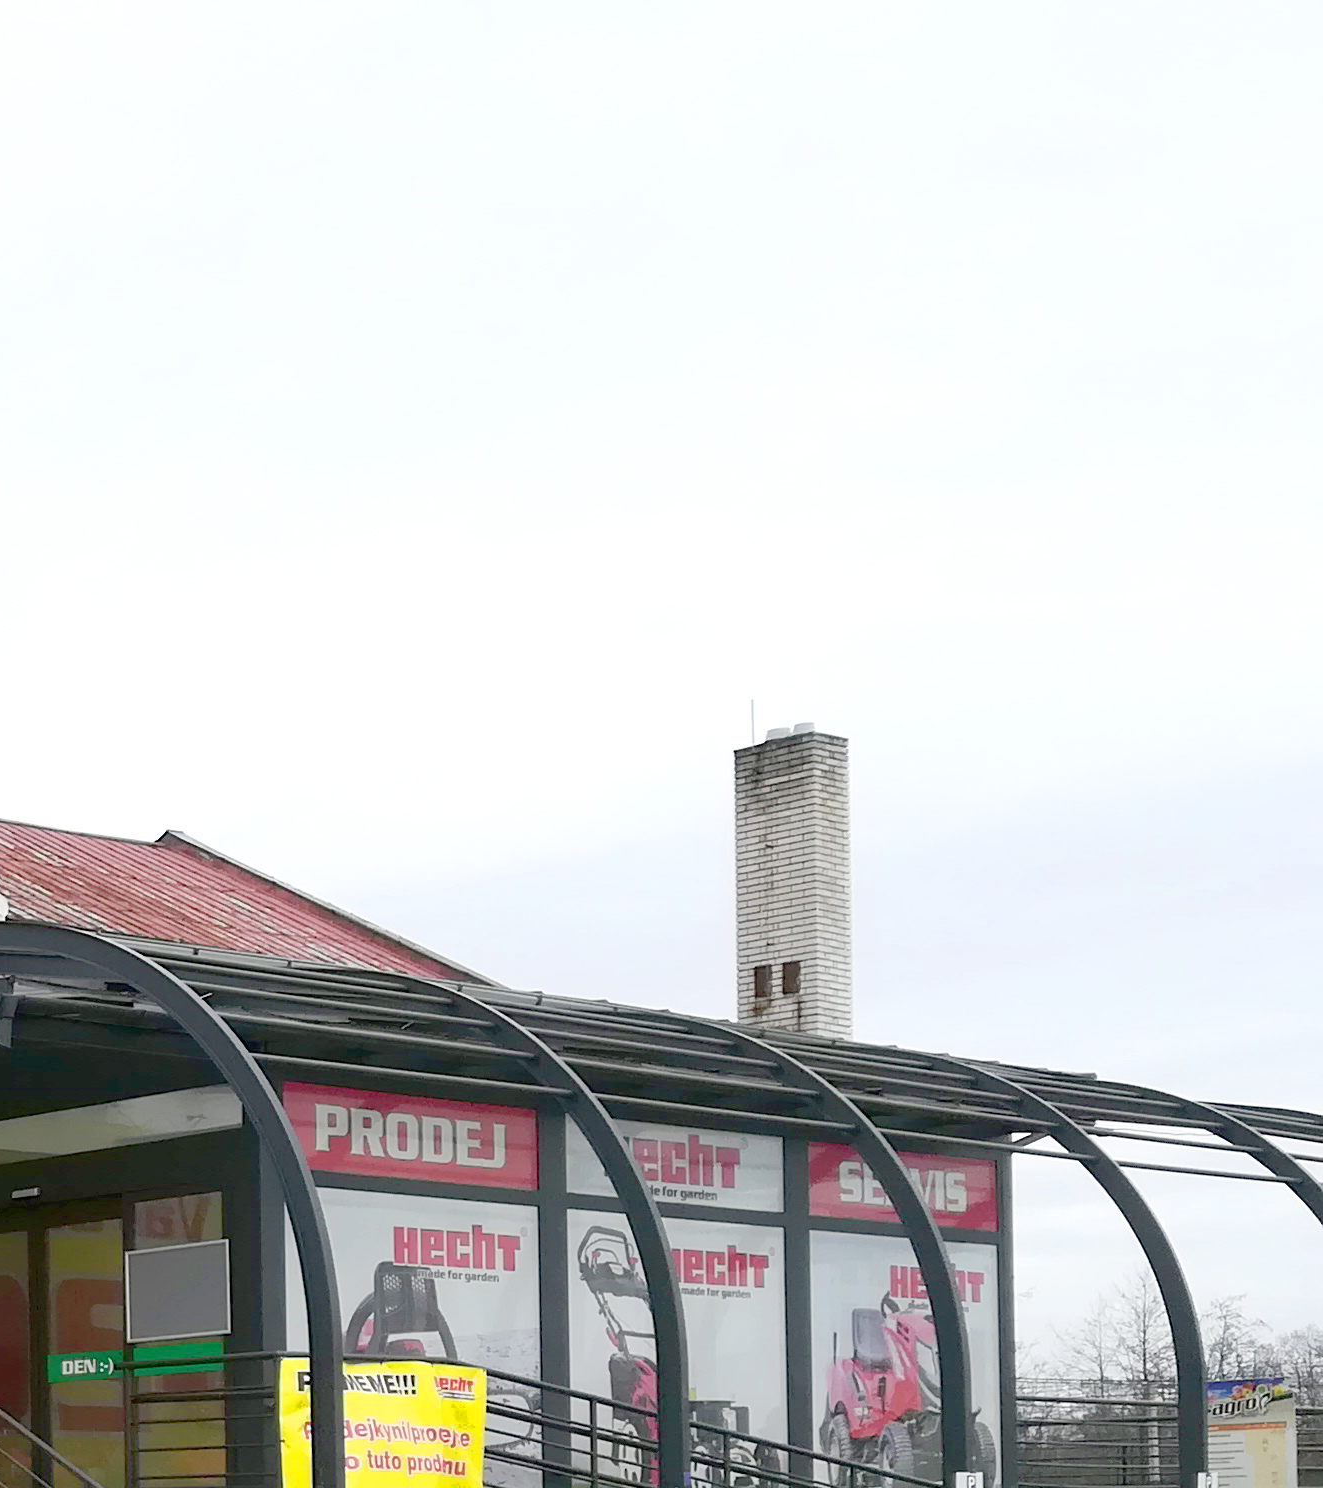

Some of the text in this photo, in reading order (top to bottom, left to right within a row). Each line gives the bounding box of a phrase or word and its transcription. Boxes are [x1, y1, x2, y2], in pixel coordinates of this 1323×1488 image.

[314, 1103, 507, 1169] PRODEJ
[662, 1186, 678, 1198] for
[680, 1188, 718, 1202] garden
[838, 1159, 969, 1214] SEVIS
[417, 1269, 500, 1284] made for garden
[61, 1358, 97, 1376] DEN
[367, 1451, 402, 1470] tuto
